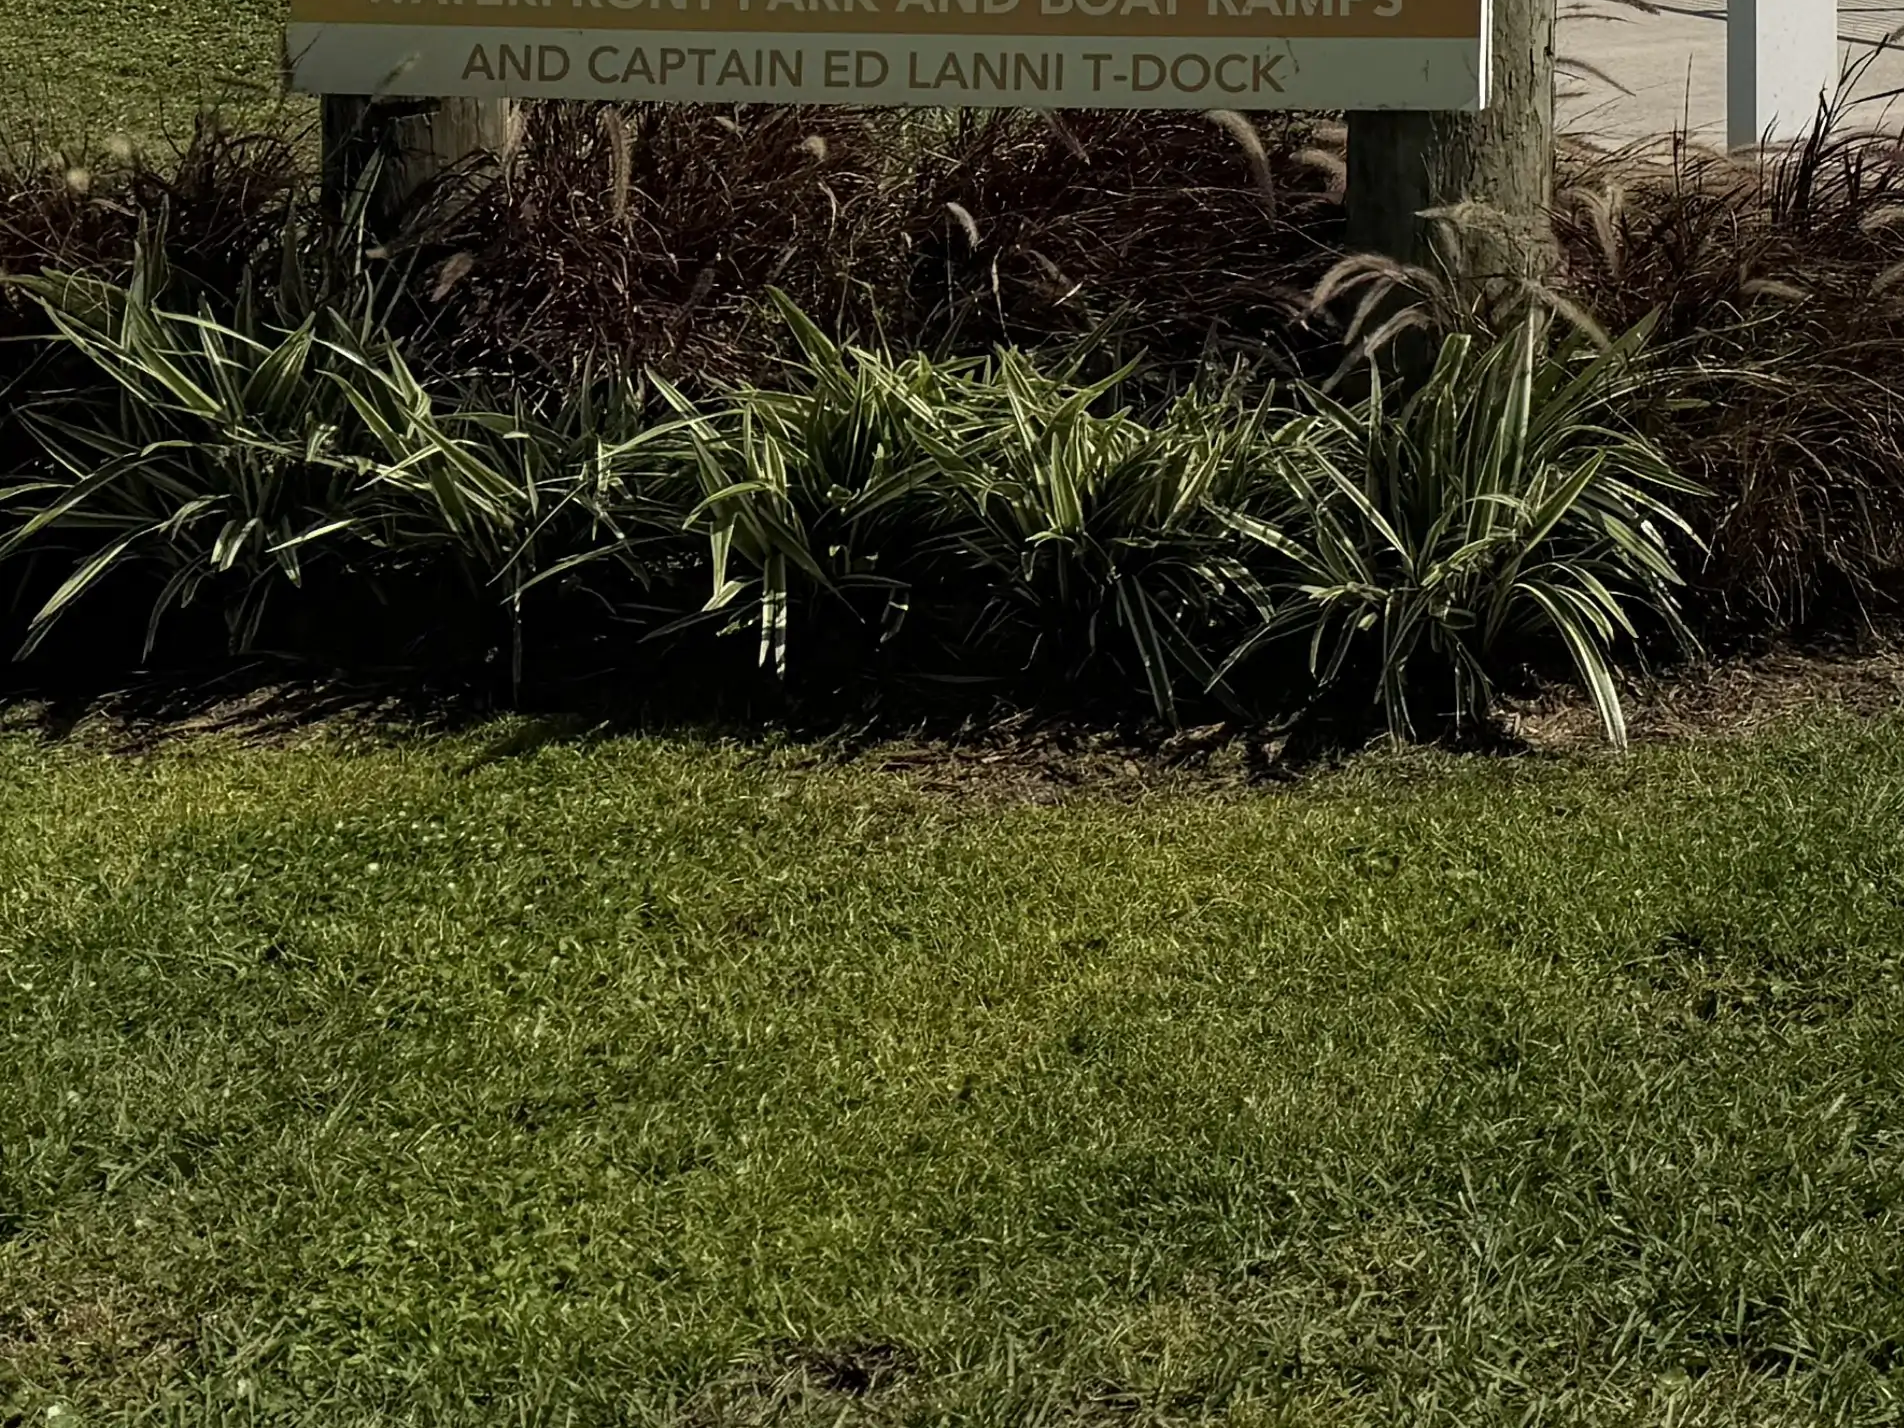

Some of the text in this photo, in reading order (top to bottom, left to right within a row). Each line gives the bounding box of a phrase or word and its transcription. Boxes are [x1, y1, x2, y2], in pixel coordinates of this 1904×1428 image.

[461, 42, 1286, 94] AND CAPTAIN ED LANNI T-DOCK
